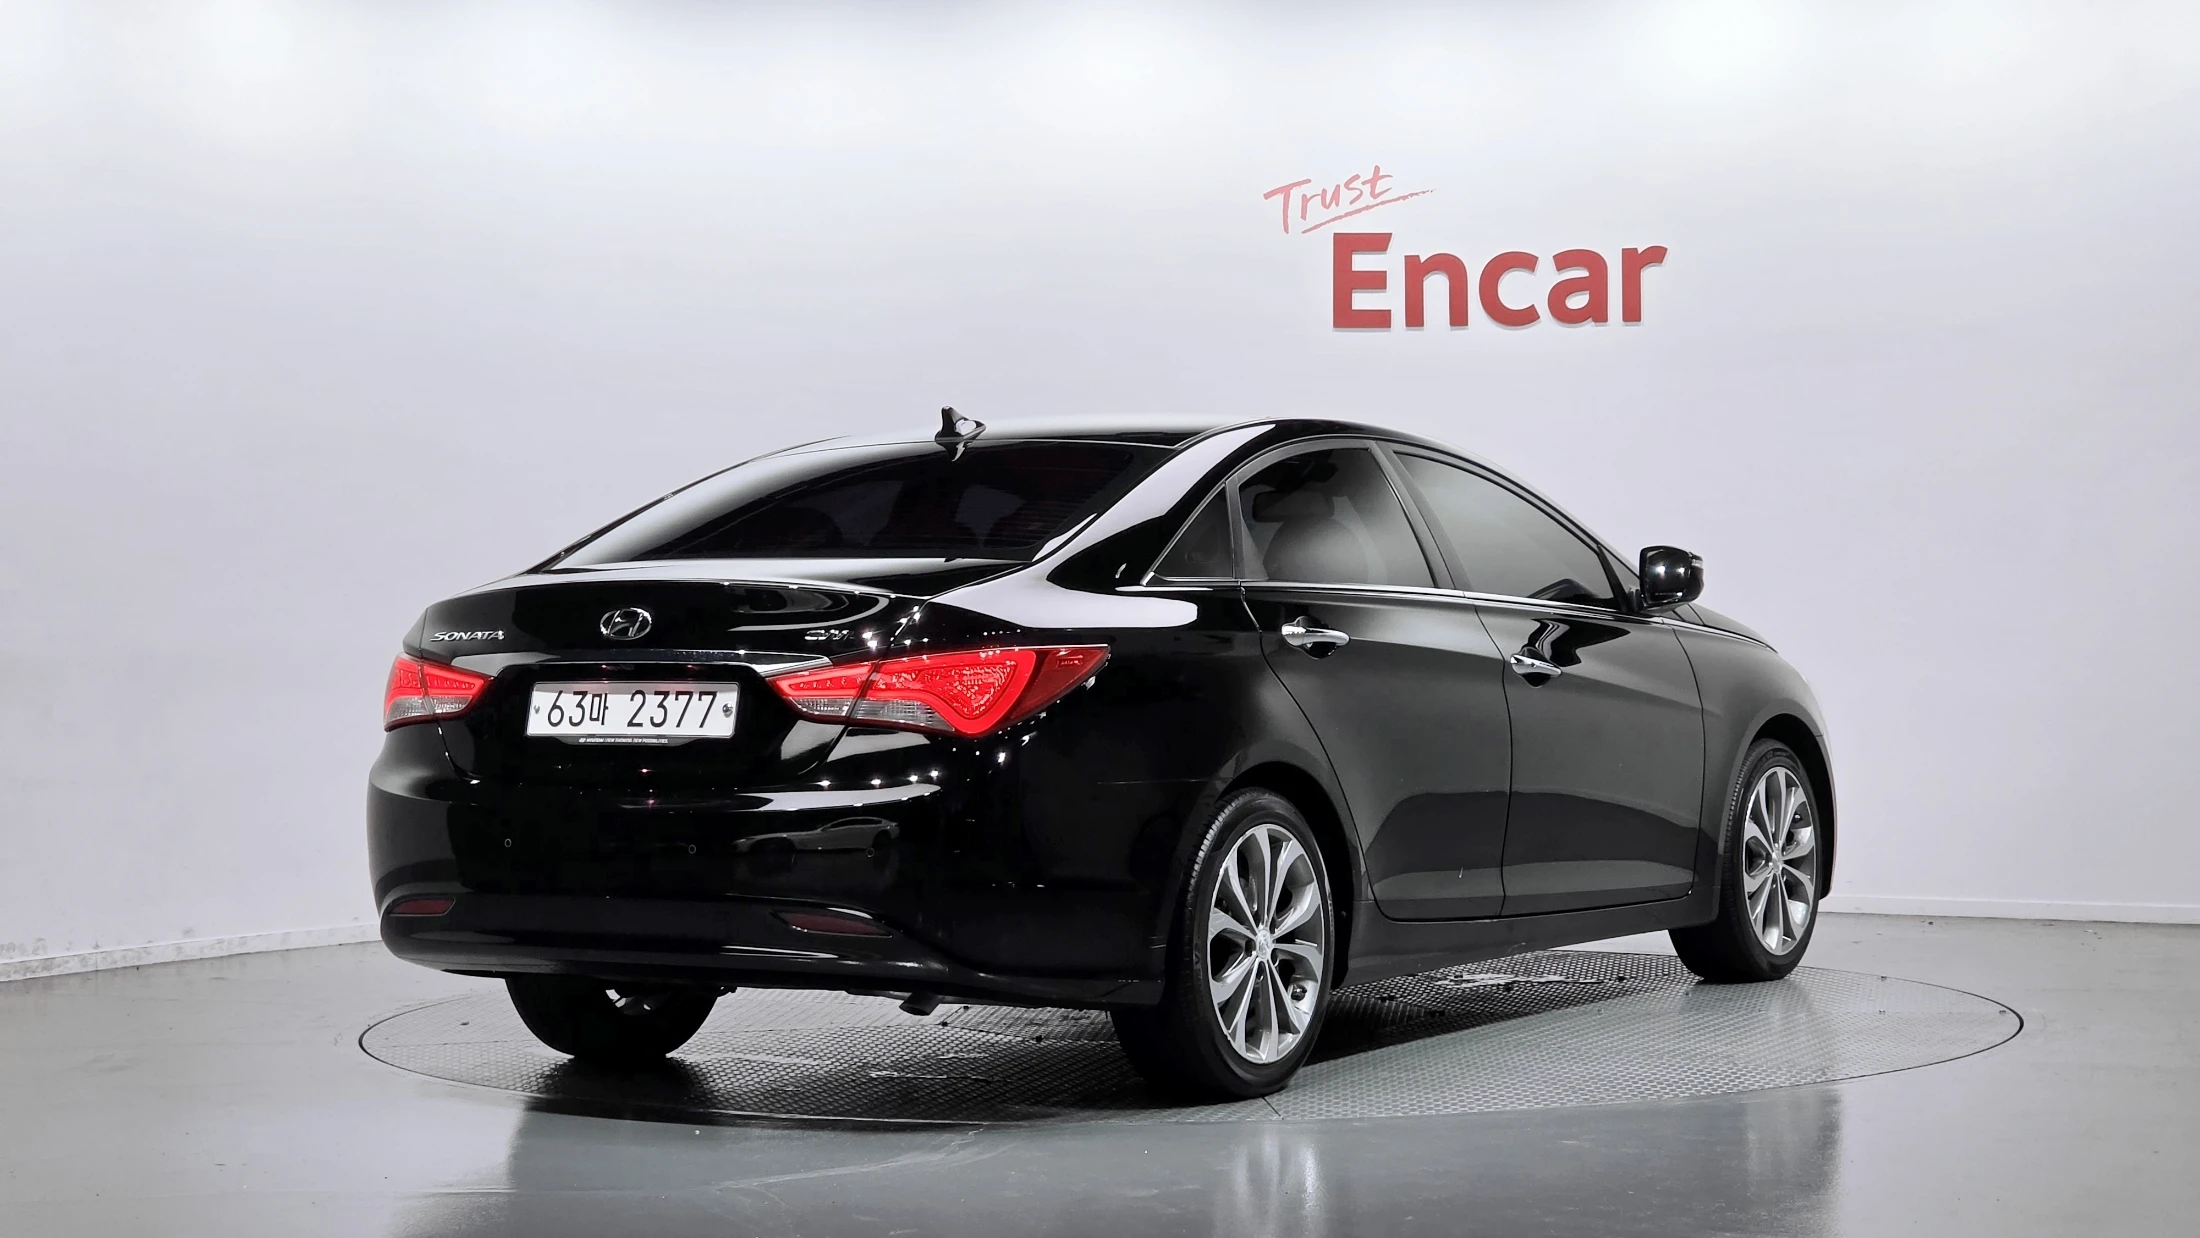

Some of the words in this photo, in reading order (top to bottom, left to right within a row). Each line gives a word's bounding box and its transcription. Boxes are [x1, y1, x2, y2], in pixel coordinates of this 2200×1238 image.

[1263, 165, 1394, 234] Trust
[1332, 232, 1669, 330] Encar
[430, 630, 504, 641] SONATA
[547, 690, 609, 728] 63마
[626, 689, 718, 729] 2377
